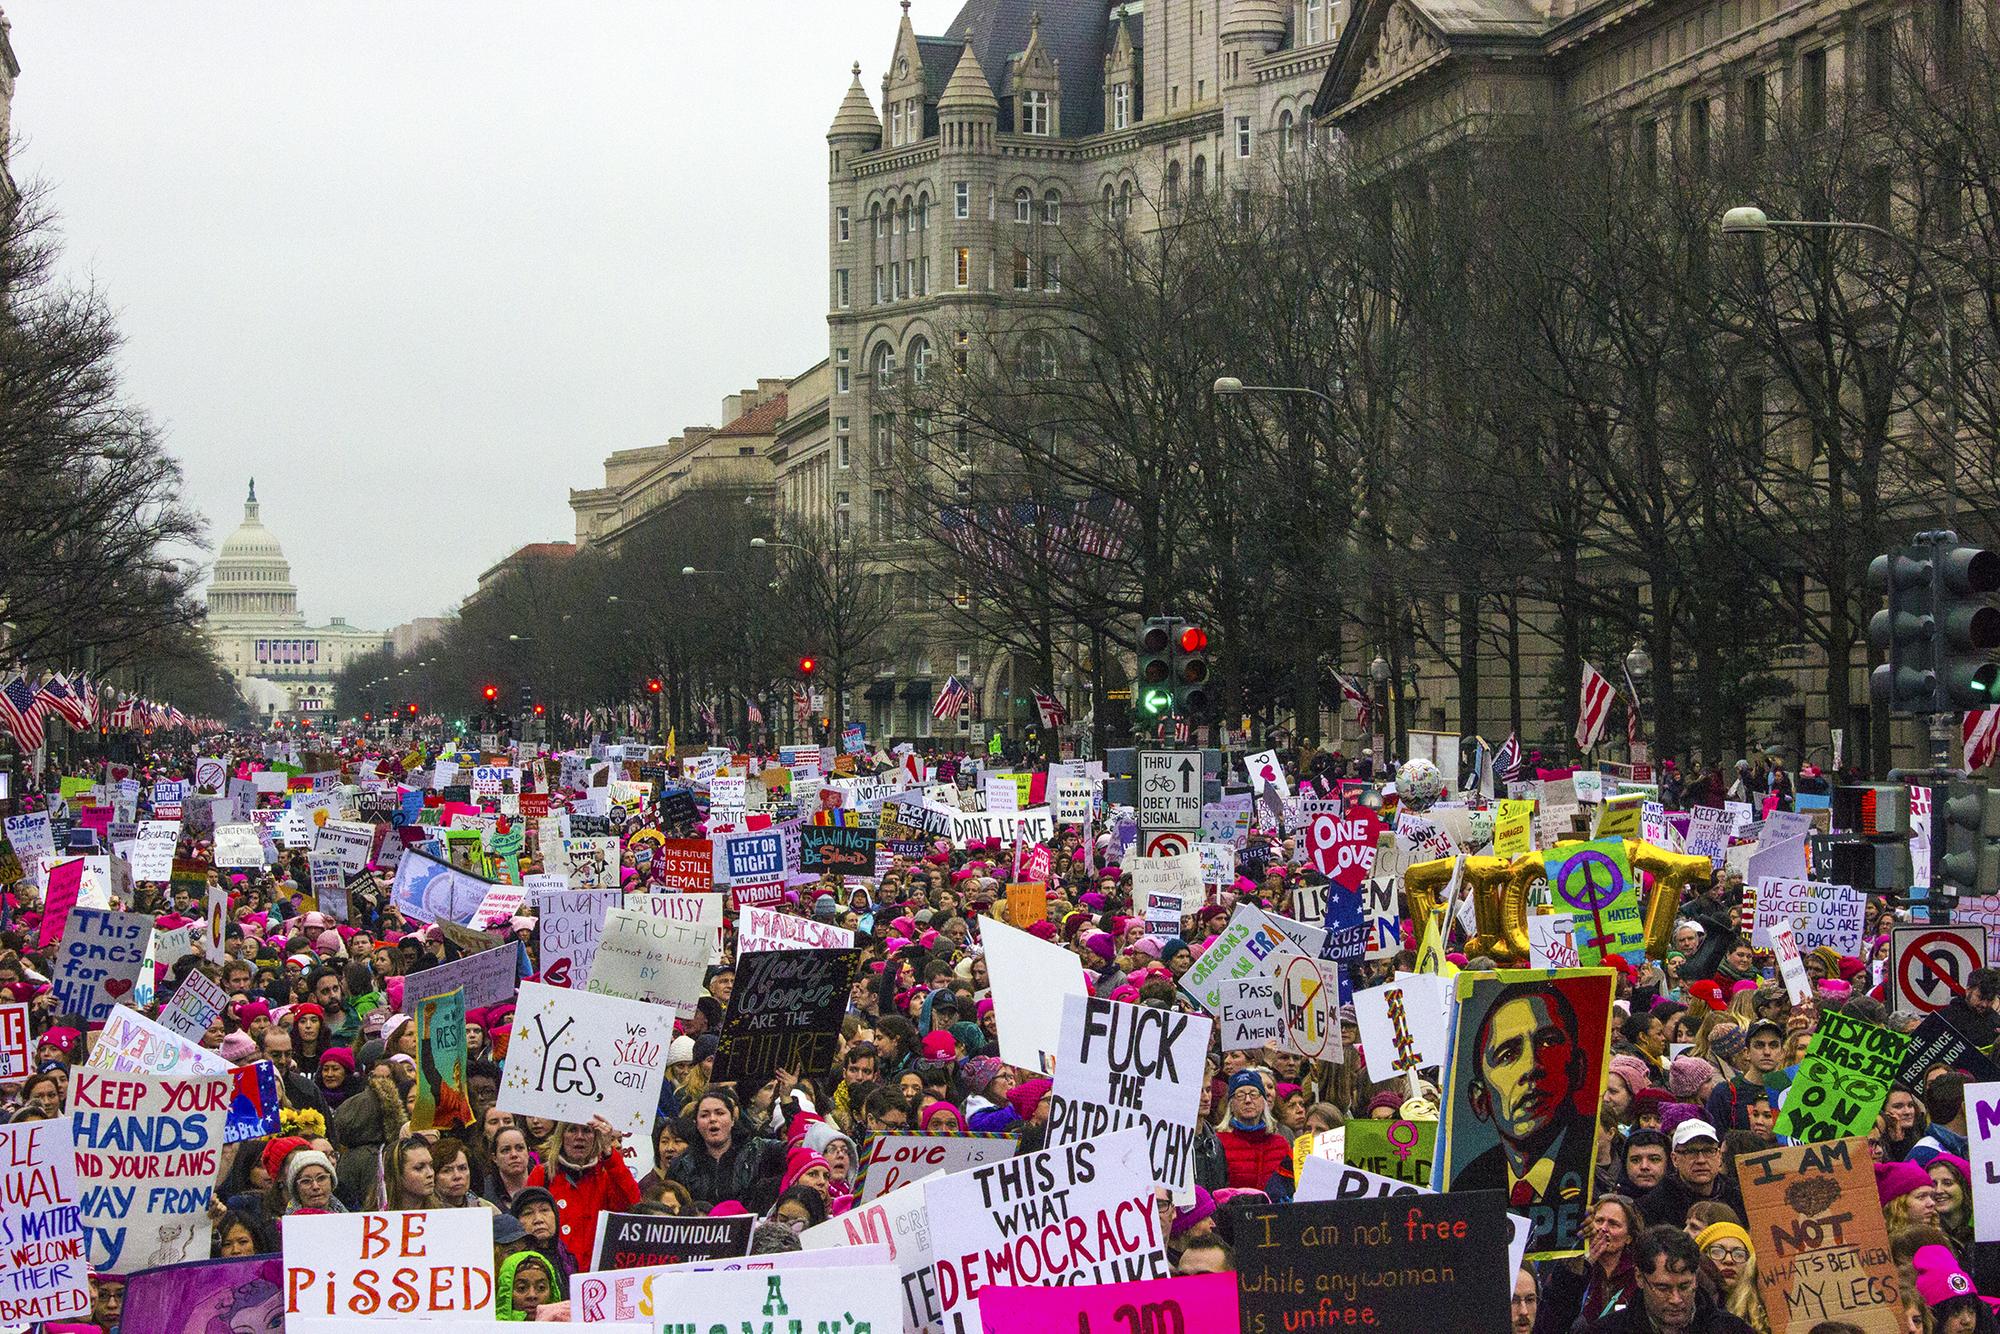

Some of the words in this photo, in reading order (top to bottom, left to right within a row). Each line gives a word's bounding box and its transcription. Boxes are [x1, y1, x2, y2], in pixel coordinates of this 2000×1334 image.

[477, 768, 514, 780] ONE
[1143, 757, 1171, 768] THRU
[157, 783, 170, 792] LEFT
[171, 783, 180, 792] OR
[711, 778, 744, 786] Feminism
[857, 787, 872, 800] NO
[157, 792, 181, 801] RIGHT
[305, 799, 331, 810] NEVER
[1059, 790, 1091, 798] WOMAN
[1143, 797, 1171, 809] OBEY
[1176, 797, 1199, 809] THIS
[157, 807, 181, 817] WRONG
[528, 806, 547, 814] STILL
[898, 803, 924, 818] BLACK
[1060, 810, 1085, 818] ROAR
[1143, 812, 1180, 824] SIGNAL
[1303, 802, 1334, 812] LOVE
[1693, 804, 1716, 821] KEEP
[1715, 808, 1737, 824] YOUR
[7, 814, 47, 831] Sisters
[452, 816, 494, 829] ANGRY
[898, 814, 923, 829] LIVES
[953, 816, 992, 842] DON'T
[1313, 816, 1369, 850] ONE
[1499, 825, 1524, 840] ENRAGED
[1646, 824, 1660, 839] BIG
[319, 832, 342, 843] NASTY
[344, 835, 369, 847] WOMEN
[731, 840, 759, 856] LEFT
[761, 838, 776, 852] OR
[892, 843, 925, 852] TRUST
[667, 849, 682, 858] THE
[683, 849, 711, 860] FUTURE
[733, 853, 777, 874] RIGHT
[1133, 859, 1139, 870] I
[1314, 844, 1377, 879] LOVE
[666, 860, 676, 871] IS
[680, 861, 710, 874] STILL
[528, 881, 564, 889] DAUGHTER
[665, 876, 710, 889] FEMALE
[735, 885, 782, 903] WRONG
[1763, 880, 1783, 899] WE
[1789, 882, 1840, 901] CANNOT
[1840, 884, 1865, 902] ALL
[543, 894, 556, 915] I
[651, 897, 704, 922] PUSSY
[1159, 900, 1180, 911] MARCH
[1607, 906, 1641, 921] HATES
[1758, 900, 1818, 914] SUCCEED
[1820, 900, 1859, 917] WHEN
[72, 909, 142, 939] This
[543, 918, 570, 934] GO
[615, 915, 708, 945] TRUTH
[750, 909, 849, 949] MADISON
[1156, 924, 1176, 933] MARCH
[1792, 916, 1810, 931] OF
[1816, 917, 1836, 931] US
[1837, 917, 1861, 932] ARE
[1245, 922, 1287, 962] ERA
[1807, 932, 1838, 948] BACK
[68, 941, 142, 964] one's
[601, 939, 642, 958] Cannot
[646, 952, 663, 961] be
[665, 953, 701, 969] hidden
[1191, 923, 1251, 988] OREGON'S
[62, 958, 109, 982] for
[639, 966, 658, 980] BY
[750, 950, 833, 988] Nasty
[185, 970, 230, 1011] BUILD
[737, 984, 834, 1014] Women
[1238, 982, 1273, 999] PASS
[176, 987, 215, 1030] BRIDGES
[749, 1012, 777, 1029] ARE
[784, 1010, 814, 1025] THE
[1223, 1004, 1275, 1022] EQUAL
[170, 1010, 196, 1031] NOT
[625, 1022, 648, 1038] We
[1079, 998, 1189, 1085] FUCK
[1817, 1011, 1913, 1060] HISTORY
[1905, 1034, 1926, 1057] THE
[533, 1013, 605, 1102] Yes,
[727, 1030, 834, 1075] FUTURE
[1815, 1037, 1864, 1073] HAS
[1901, 1030, 1954, 1083] RESISTANCE
[1941, 1040, 1967, 1066] NOW
[74, 1072, 148, 1110] KEEP
[159, 1079, 228, 1113] YOUR
[613, 1069, 648, 1094] can!
[1107, 1072, 1146, 1111] THE
[1800, 1085, 1861, 1127] ON
[72, 1111, 209, 1153] HANDS
[868, 1135, 946, 1165] Love
[966, 1147, 984, 1163] is
[107, 1154, 160, 1179] YOUR
[163, 1149, 216, 1178] LAWS
[1744, 1152, 1787, 1186] I
[1798, 1140, 1853, 1175] AM
[973, 1152, 1056, 1209] THIS
[1065, 1142, 1097, 1186] IS
[146, 1185, 213, 1215] FROM
[21, 1205, 84, 1244] MATTER
[992, 1189, 1071, 1239] WHAT
[359, 1212, 428, 1260] BE
[618, 1222, 642, 1243] AS
[644, 1223, 733, 1245] INDIVIDUAL
[842, 1204, 897, 1263] NO
[1301, 1222, 1340, 1247] am
[1353, 1217, 1393, 1247] not
[1403, 1206, 1468, 1242] free
[1769, 1212, 1854, 1256] NOT
[10, 1236, 85, 1269] WELCOME
[936, 1192, 1157, 1313] DEMOCRACY
[7, 1263, 73, 1292] THEIR
[1760, 1255, 1827, 1288] WHAT'S
[1826, 1247, 1893, 1275] BETWEEN
[1241, 1264, 1304, 1296] while
[1315, 1268, 1359, 1300] any
[1360, 1264, 1456, 1291] woman
[761, 1274, 789, 1317] A
[1781, 1280, 1831, 1321] MY
[1836, 1275, 1899, 1312] LEGS
[1246, 1309, 1266, 1334] is
[1283, 1297, 1382, 1333] unfree,
